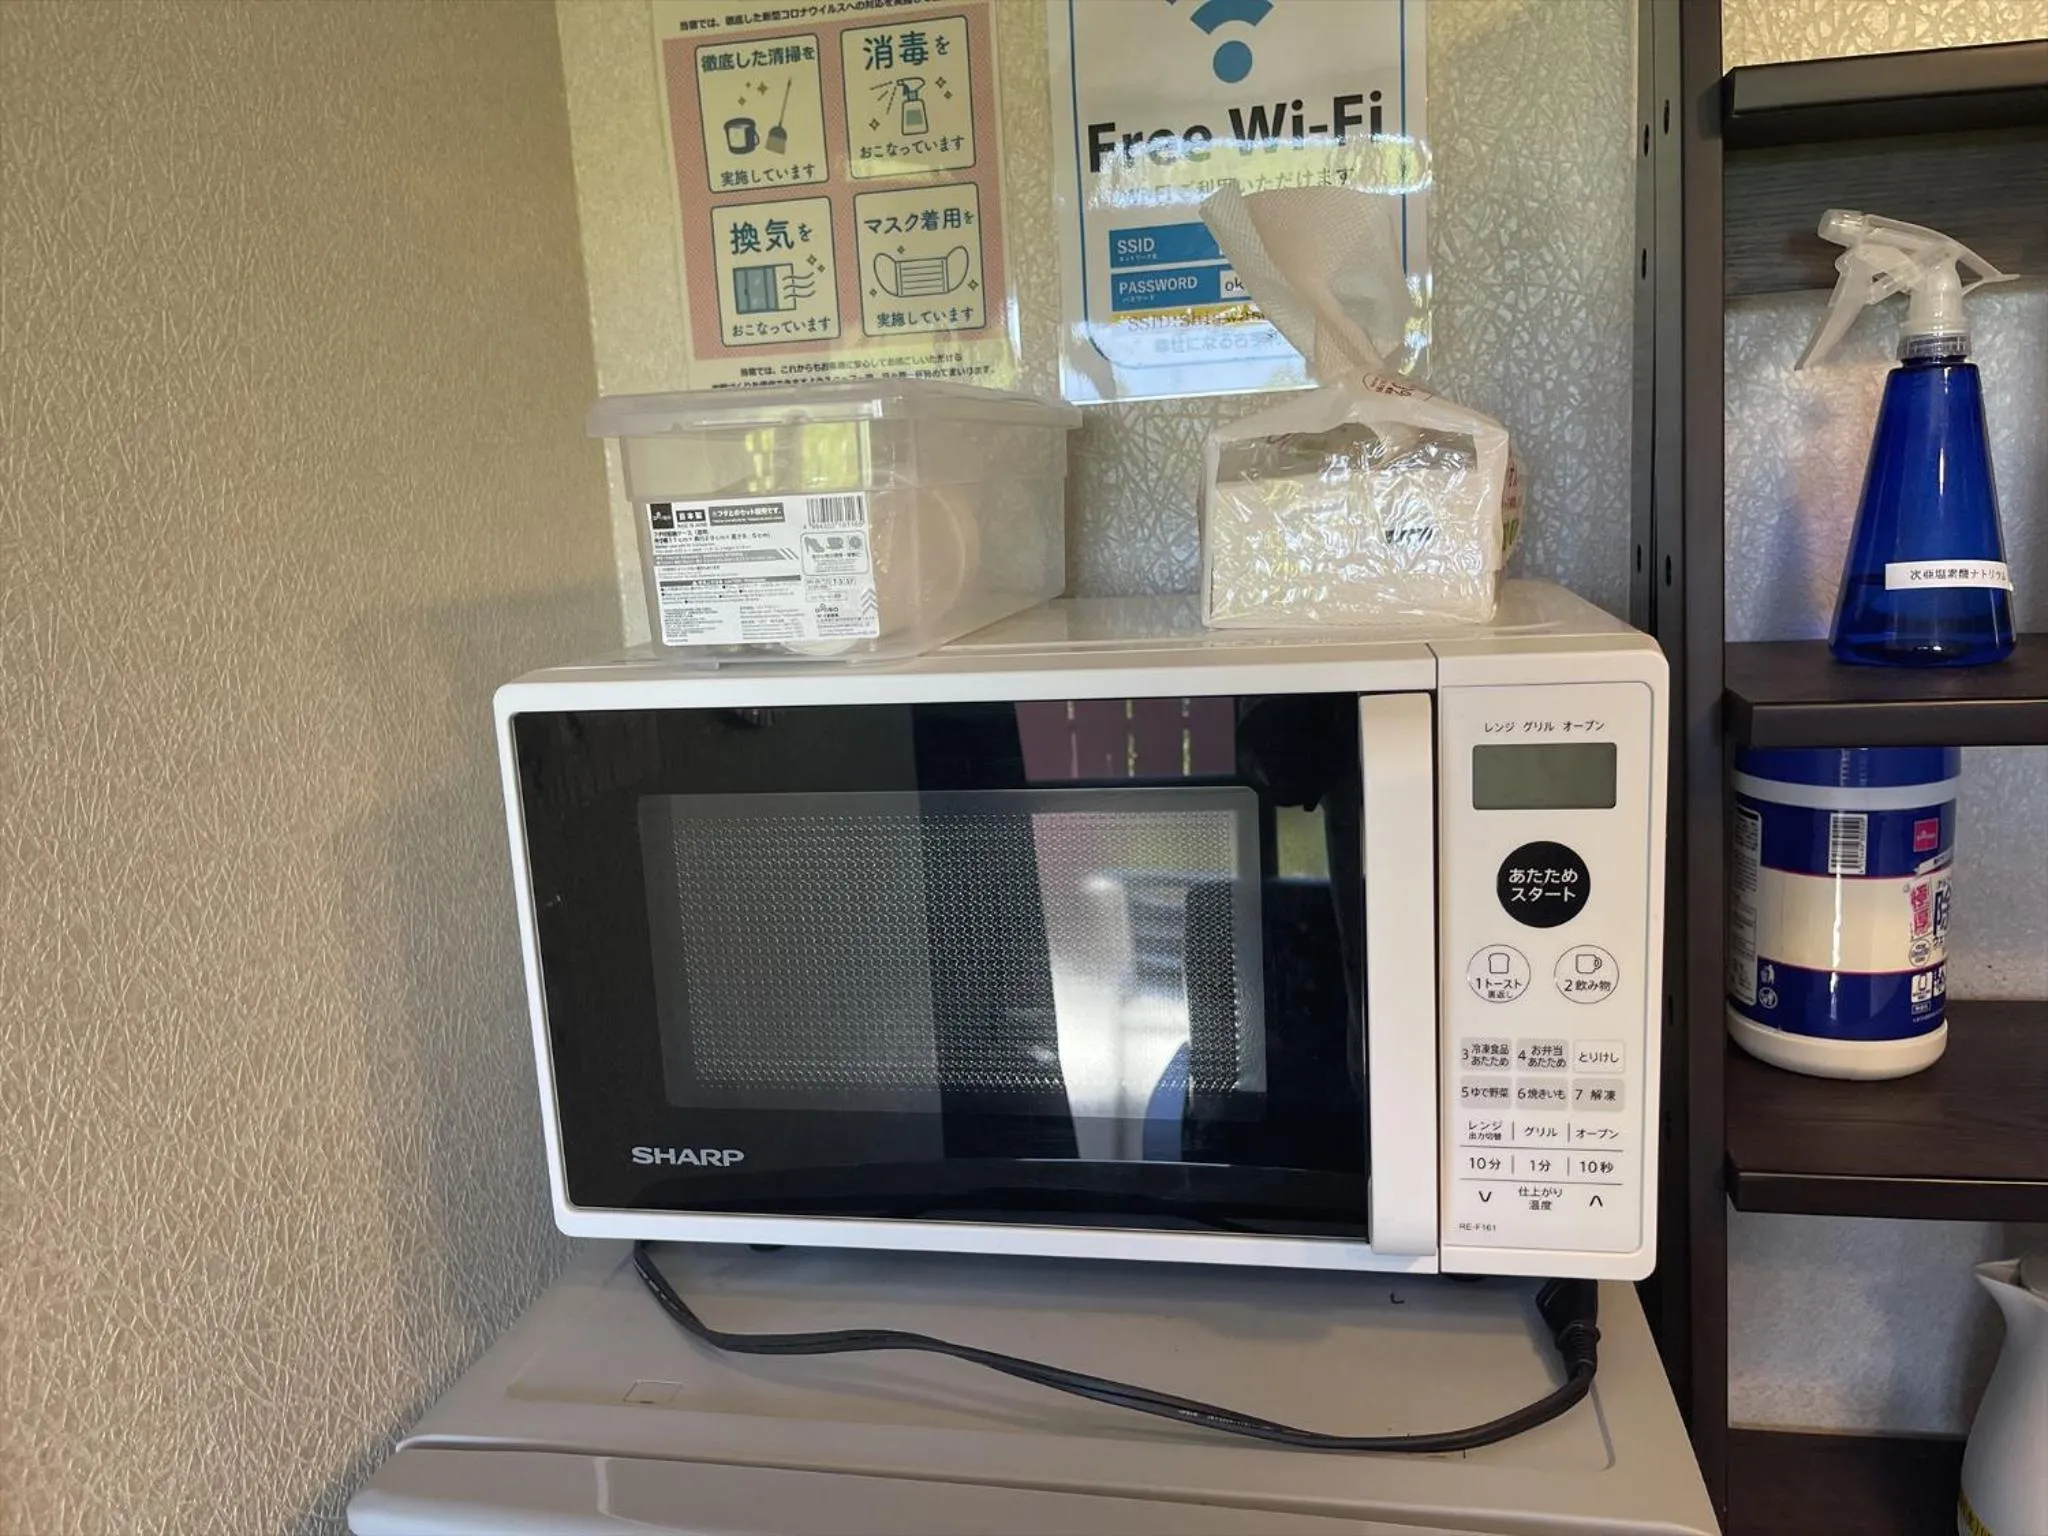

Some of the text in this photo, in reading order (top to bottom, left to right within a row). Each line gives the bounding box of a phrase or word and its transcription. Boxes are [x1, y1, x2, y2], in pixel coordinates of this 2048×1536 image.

[864, 30, 950, 71] 消毒を
[700, 45, 816, 73] 徹底した清掃を
[1088, 90, 1382, 173] Free Wi-Fi
[859, 136, 965, 159] おこなっています
[720, 164, 815, 186] 実施しています
[863, 207, 975, 235] マスク着用を
[730, 218, 813, 255] 換気を
[1117, 237, 1155, 255] SSID
[1119, 276, 1198, 295] PASSWORD
[877, 306, 974, 328] 実施しています
[732, 317, 831, 338] おこなっています
[1484, 720, 1606, 733] レンジ グリル オープン
[1508, 867, 1579, 884] あたため
[1511, 887, 1577, 902] スタート
[1471, 1043, 1510, 1056] 冷凍食品
[1531, 1044, 1564, 1057] お弁当
[1471, 1056, 1510, 1067] あたため
[1527, 1056, 1567, 1068] あたため
[1578, 1051, 1620, 1063] とりけし
[1468, 1119, 1503, 1131] レンジ
[1524, 1126, 1559, 1137] グリル
[1575, 1128, 1620, 1140] オープン
[631, 1146, 745, 1167] SHARP
[1469, 1157, 1501, 1170] 10分
[1530, 1159, 1552, 1172] 1分
[1580, 1160, 1614, 1174] 10秒
[1518, 1186, 1563, 1198] 仕上がり
[1528, 1200, 1552, 1211] 温度
